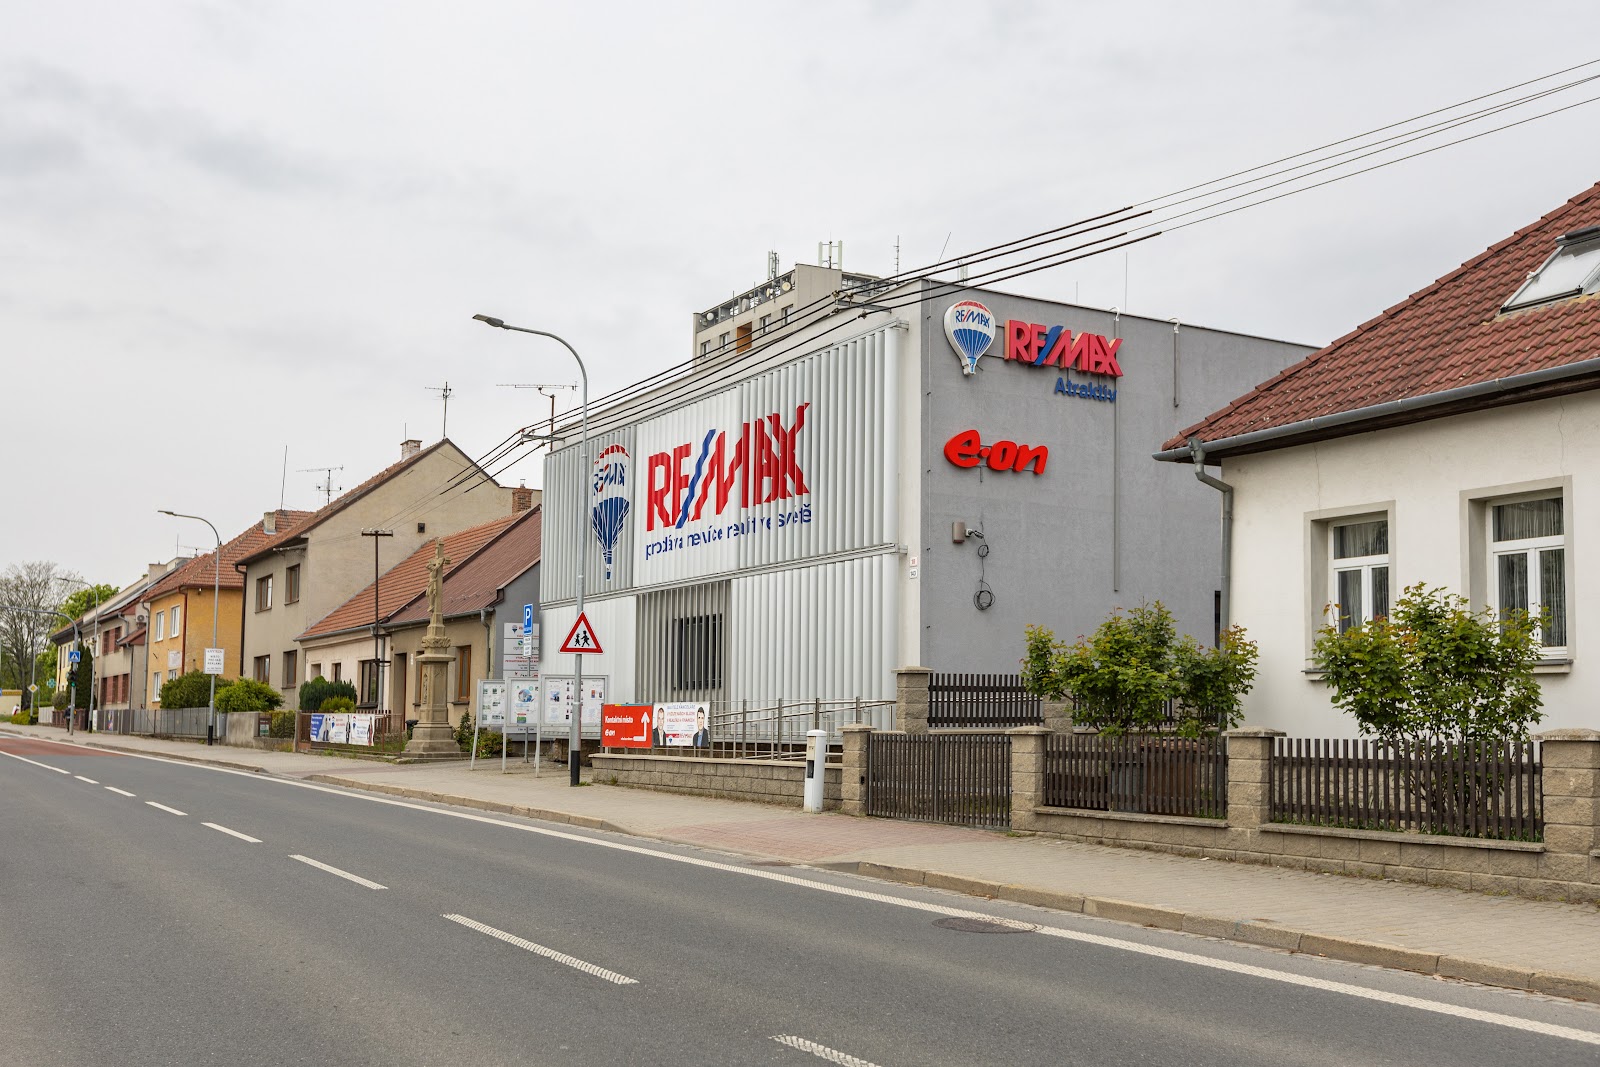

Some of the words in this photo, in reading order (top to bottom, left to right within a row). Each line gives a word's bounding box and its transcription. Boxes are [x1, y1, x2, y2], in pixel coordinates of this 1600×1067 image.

[956, 310, 990, 328] RE/MAX
[1004, 320, 1123, 377] RE/MAX
[1055, 377, 1117, 403] Atraktiv
[647, 402, 810, 531] RE/MAX
[526, 608, 530, 625] P
